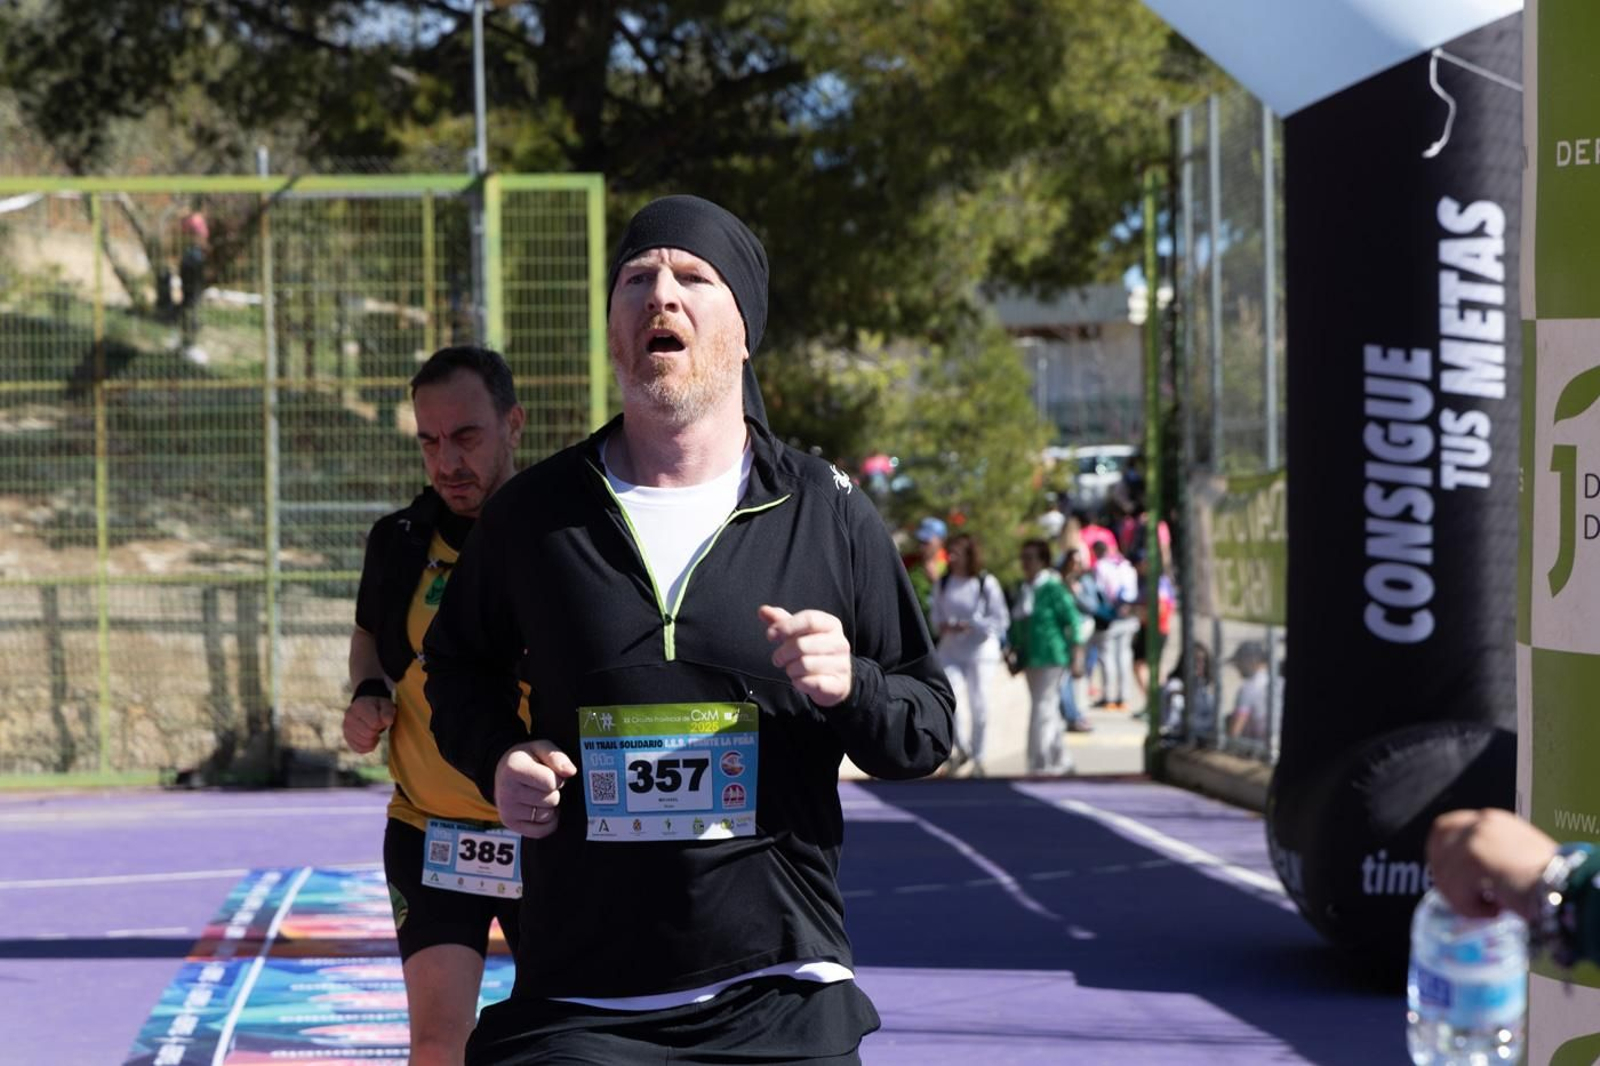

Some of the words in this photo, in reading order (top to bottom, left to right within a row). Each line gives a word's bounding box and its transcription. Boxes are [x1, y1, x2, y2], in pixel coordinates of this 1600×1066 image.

[1437, 196, 1505, 399] METAS
[1438, 407, 1491, 490] TUS
[1363, 344, 1435, 644] CONSIGUE
[690, 709, 719, 722] CxM
[690, 721, 719, 733] 2025
[584, 741, 595, 750] VII
[596, 740, 618, 750] TRAIL
[619, 739, 663, 749] SOLIDARIO
[628, 758, 709, 794] 357
[458, 838, 515, 866] 385
